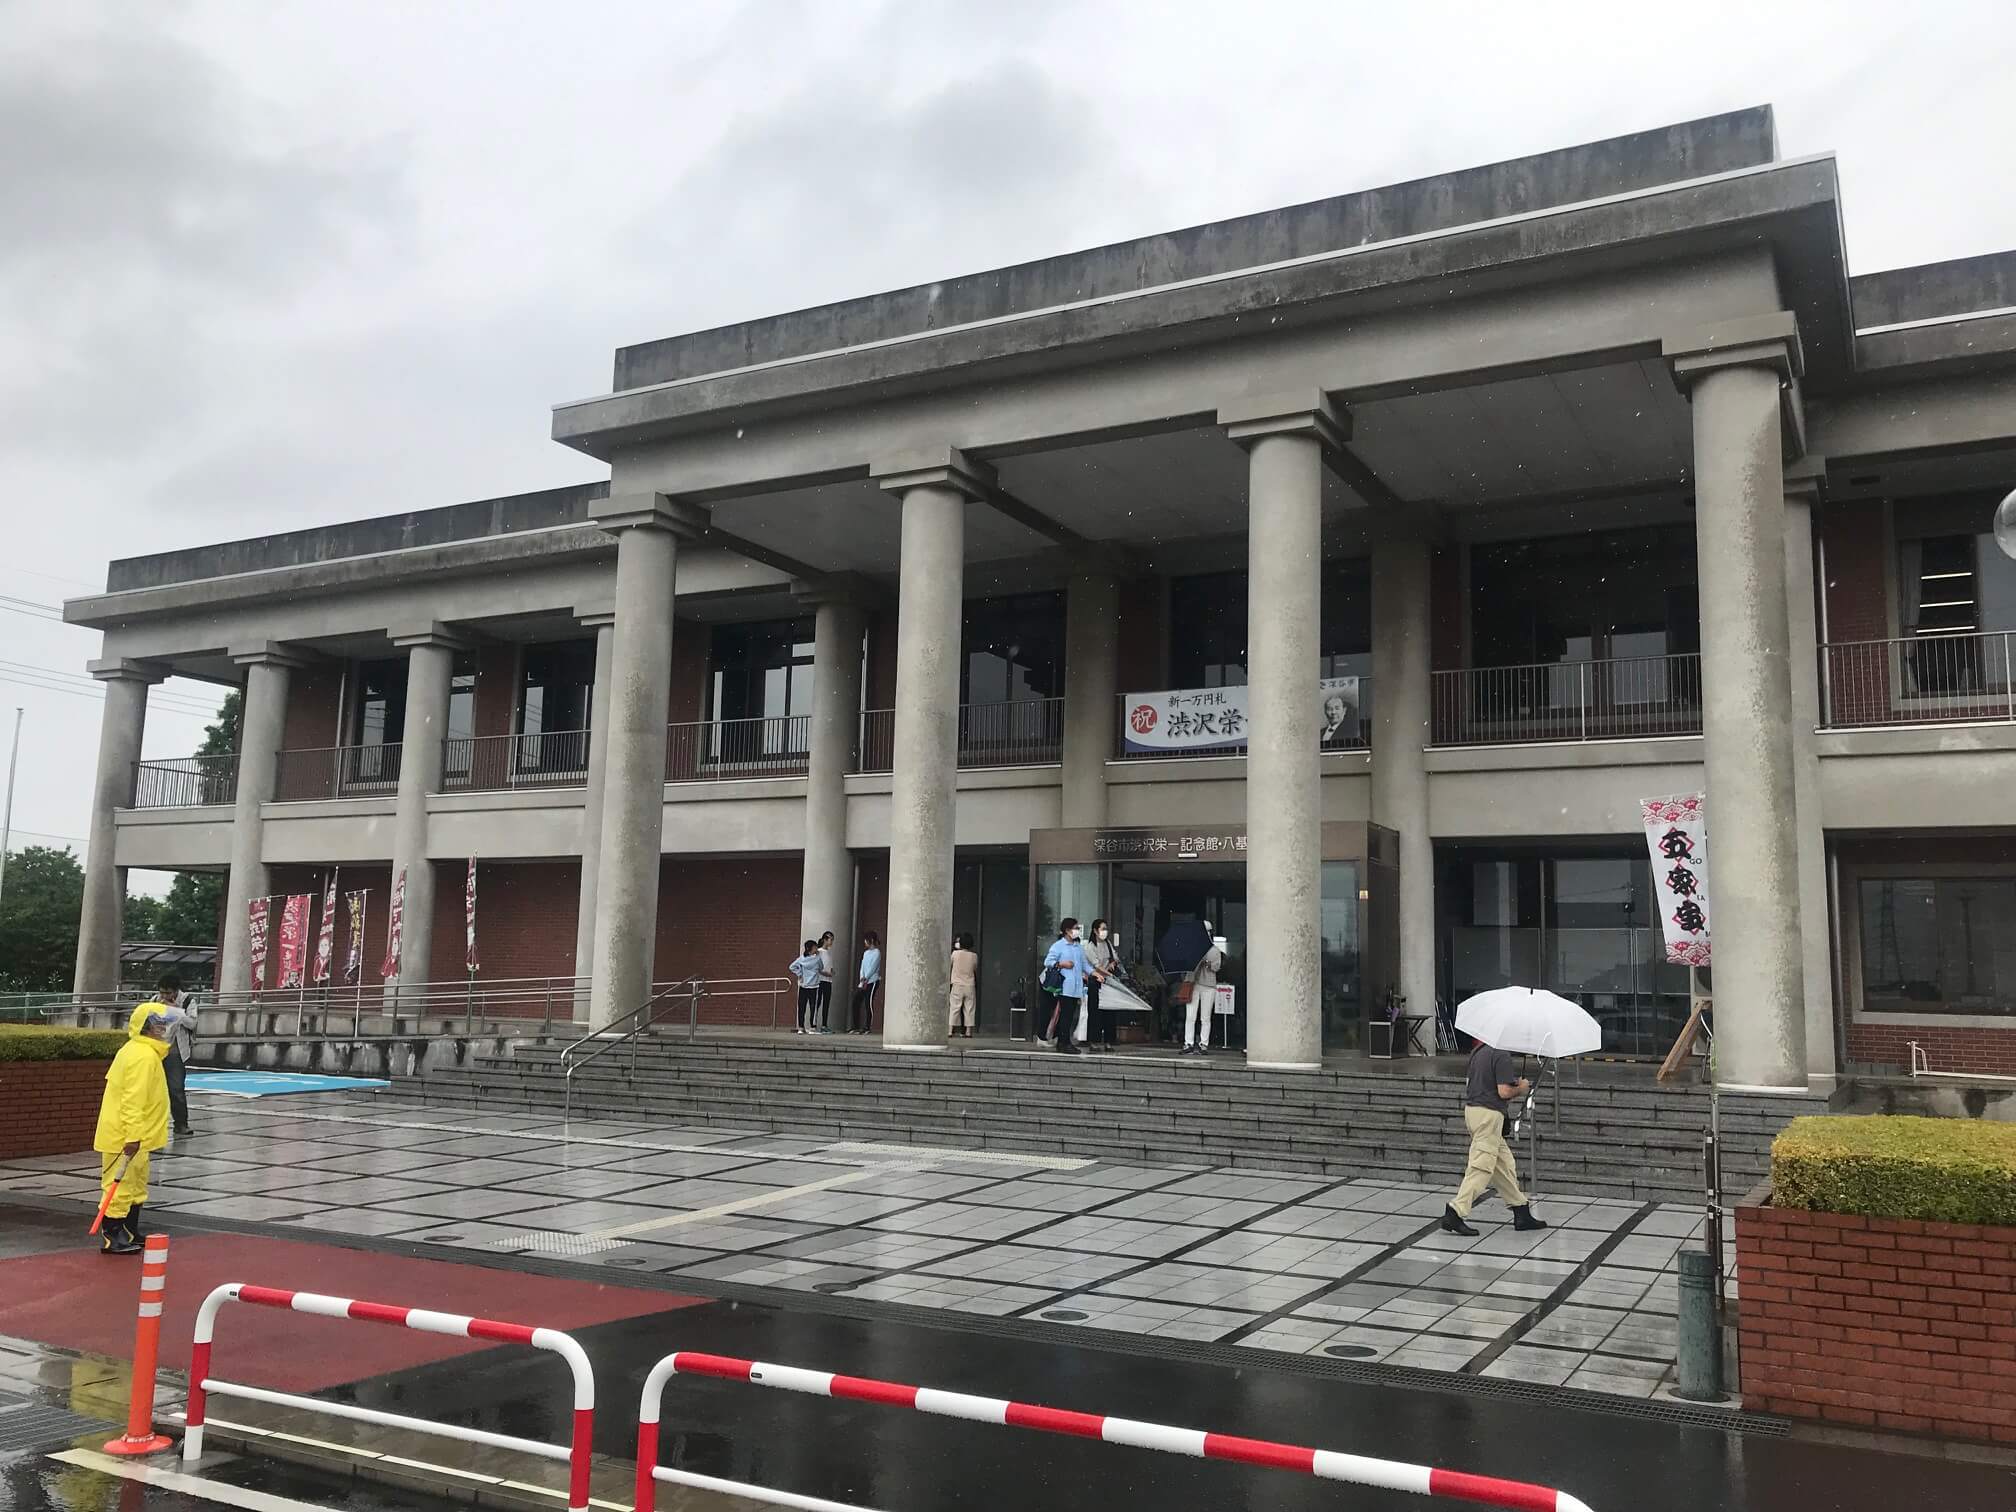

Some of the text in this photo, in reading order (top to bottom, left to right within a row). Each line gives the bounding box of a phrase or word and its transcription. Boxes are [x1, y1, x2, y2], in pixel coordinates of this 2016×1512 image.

[1168, 692, 1227, 709] 新一万円札
[1132, 708, 1155, 731] 祝
[1167, 708, 1248, 738] 渋沢栄
